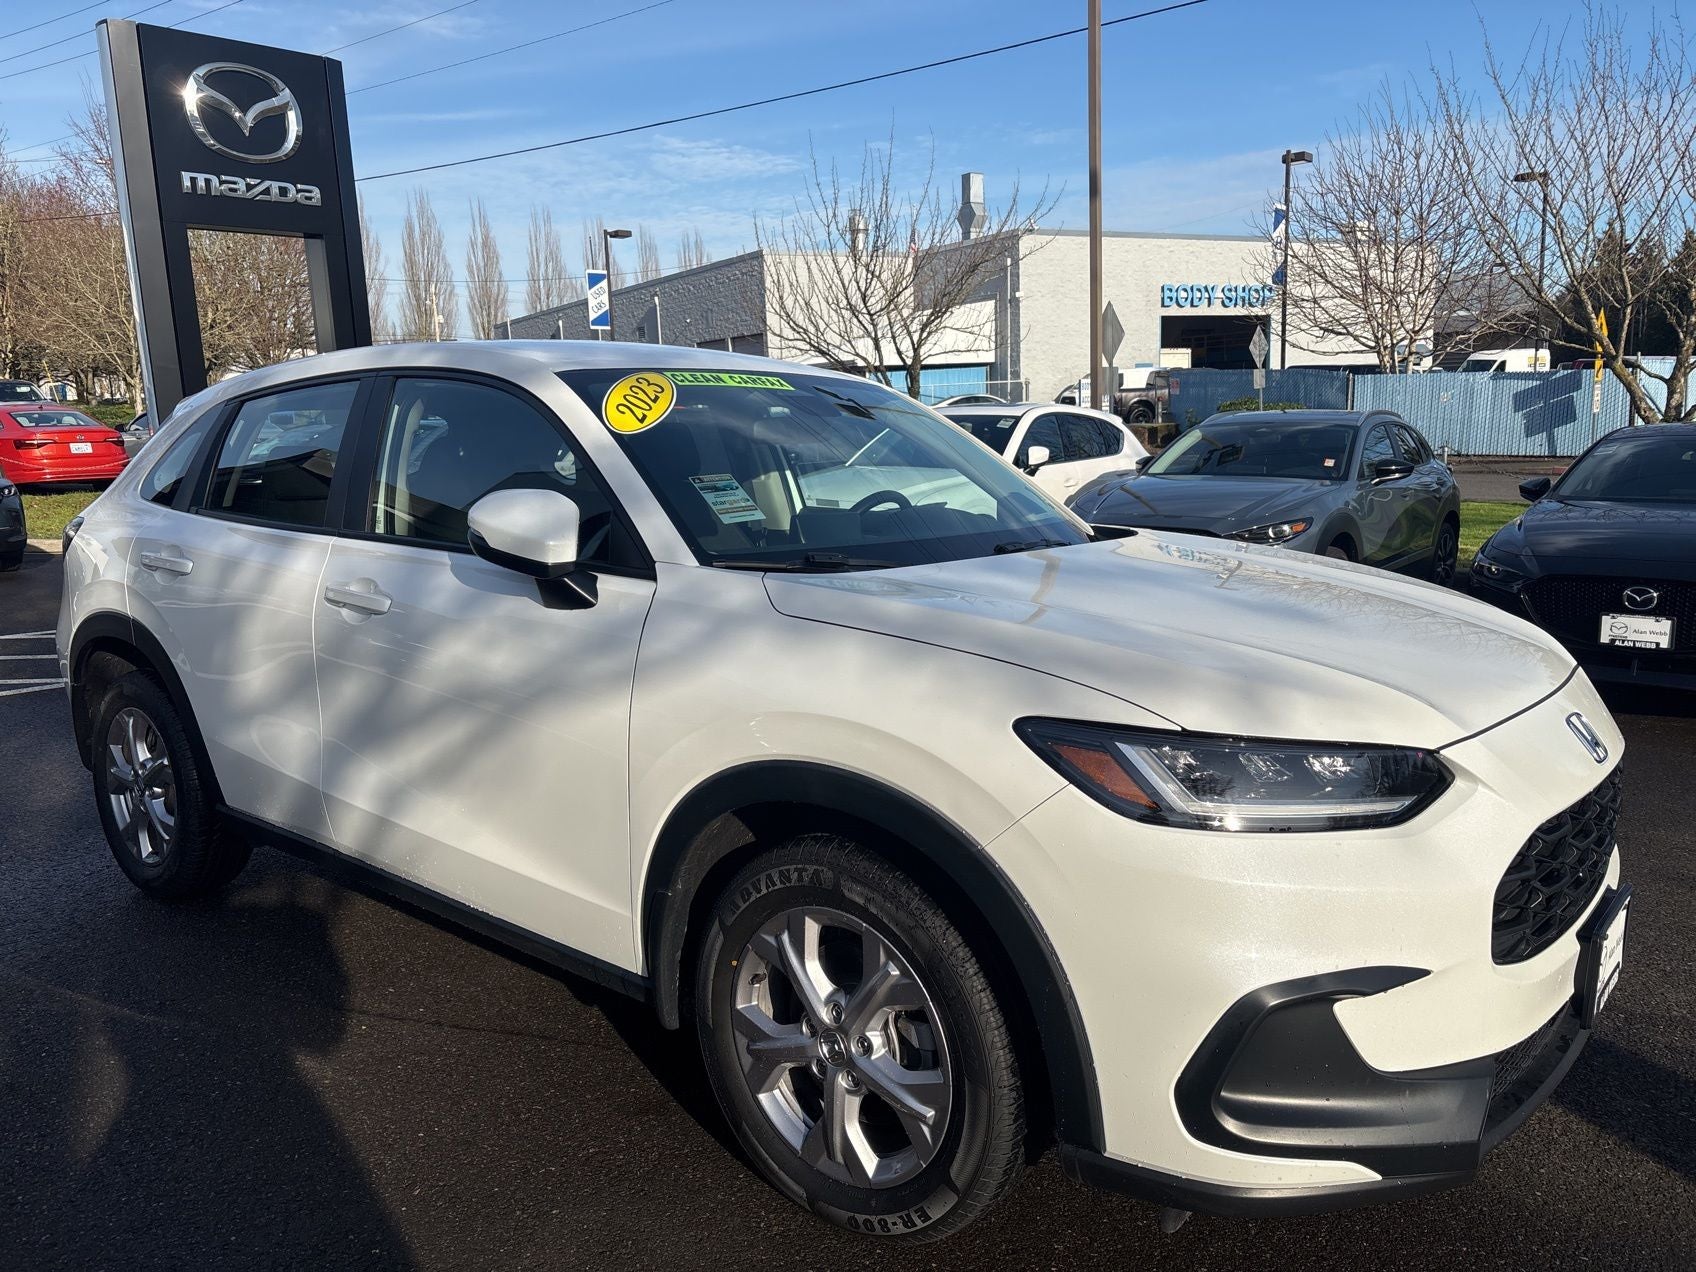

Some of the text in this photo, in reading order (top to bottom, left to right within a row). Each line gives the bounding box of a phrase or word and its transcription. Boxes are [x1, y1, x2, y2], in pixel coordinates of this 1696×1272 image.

[590, 286, 607, 300] USED
[1160, 284, 1277, 308] BODY SHOP
[591, 300, 607, 314] CARS
[671, 373, 787, 389] CLEAN CARFAX
[615, 376, 665, 424] 2023
[1614, 639, 1657, 649] ALAN WEBB
[728, 866, 826, 914] ADVANTA
[846, 1206, 933, 1233] ER-800
